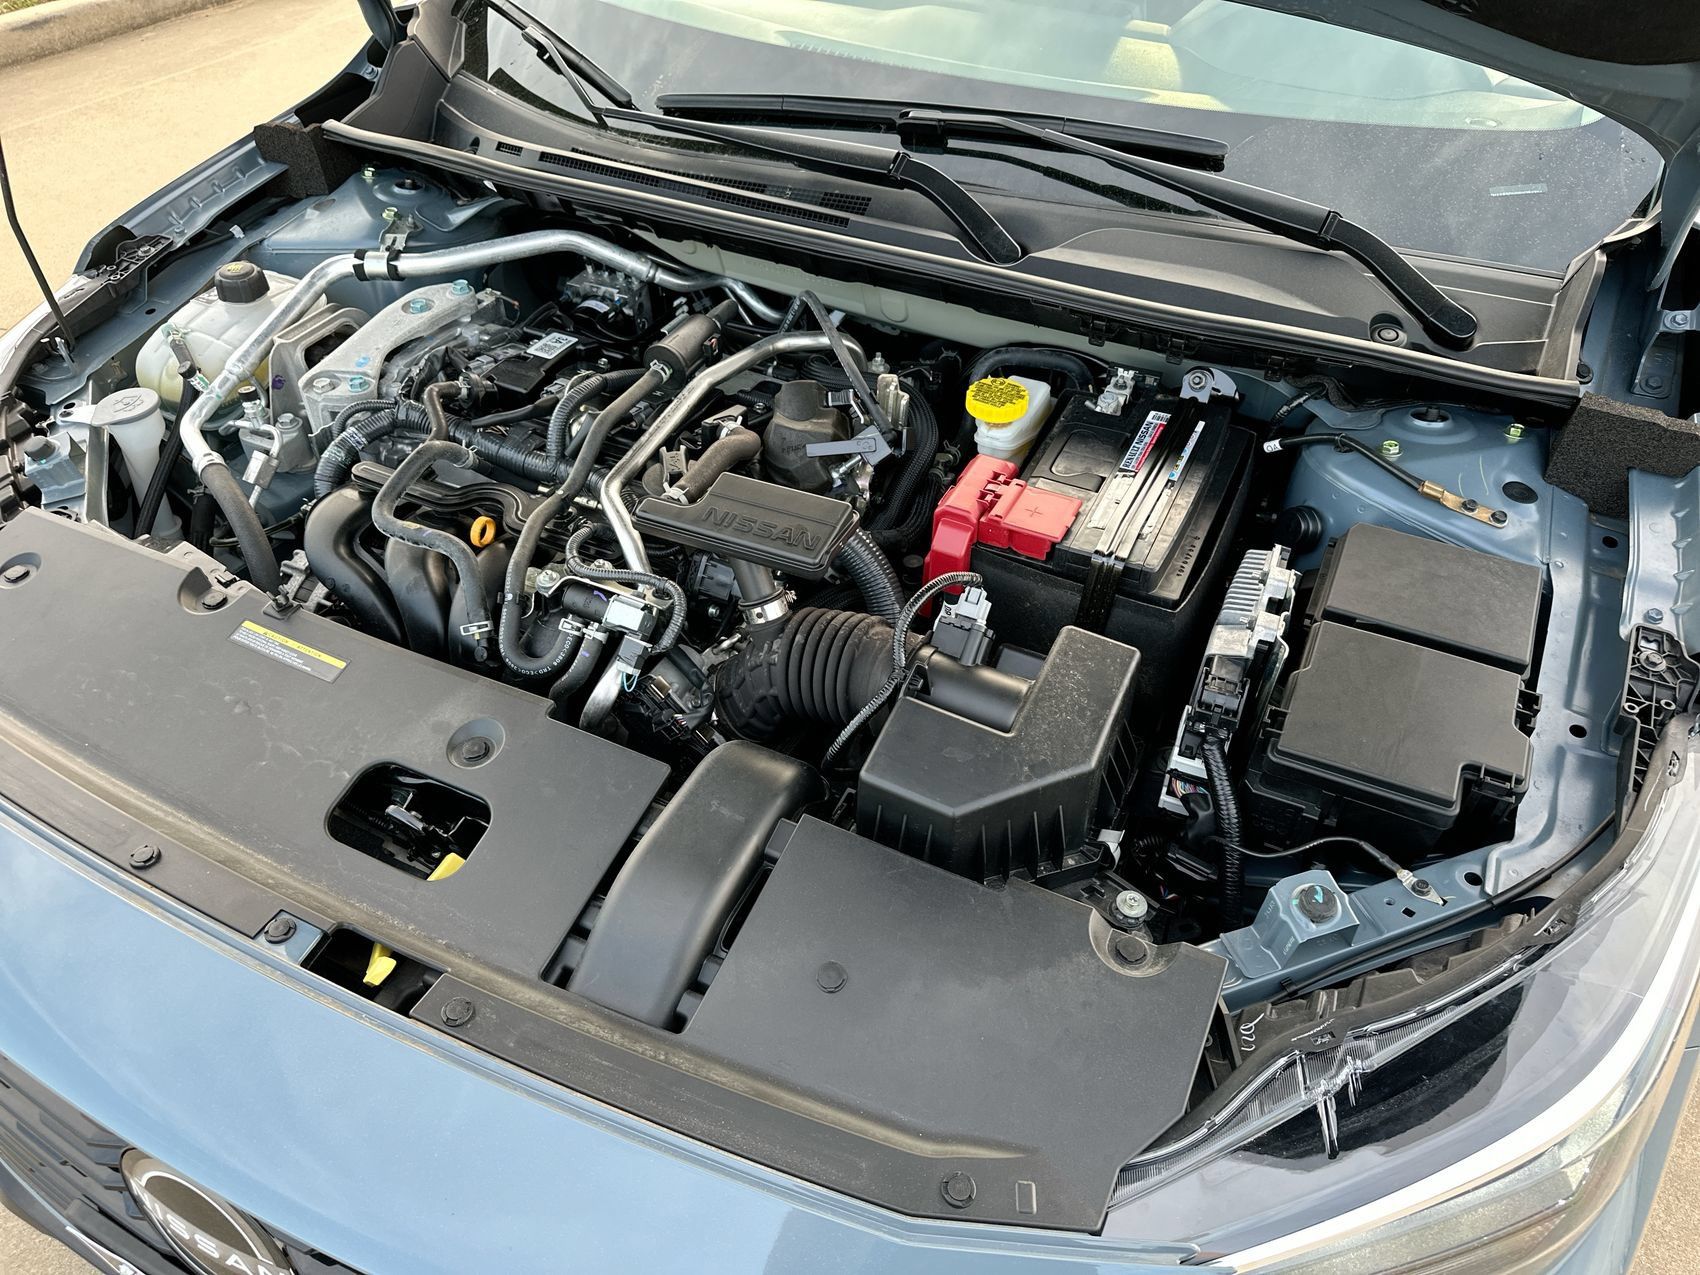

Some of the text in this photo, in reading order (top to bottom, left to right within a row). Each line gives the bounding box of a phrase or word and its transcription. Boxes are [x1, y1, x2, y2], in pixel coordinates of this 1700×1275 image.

[1122, 445, 1140, 468] RENAULT
[1135, 421, 1153, 446] NISSAN
[702, 505, 821, 550] NISSAN
